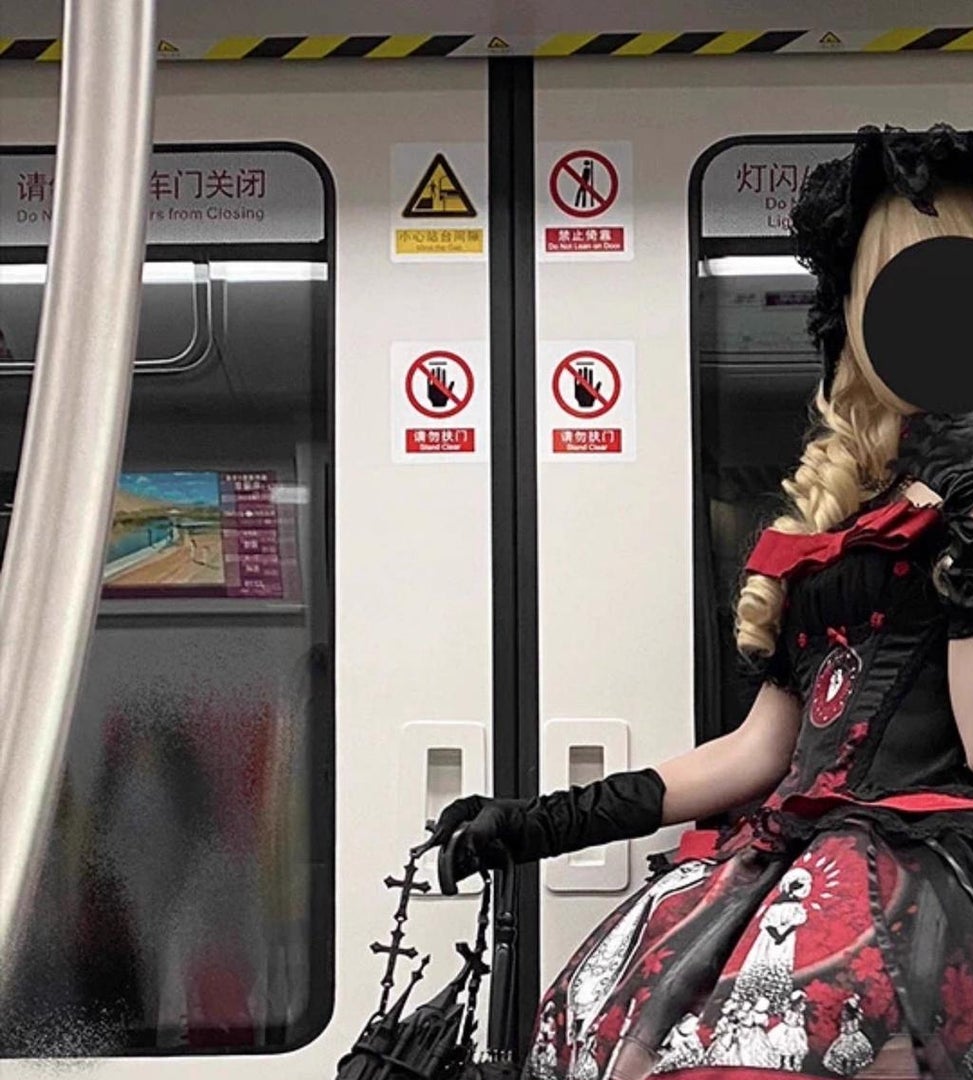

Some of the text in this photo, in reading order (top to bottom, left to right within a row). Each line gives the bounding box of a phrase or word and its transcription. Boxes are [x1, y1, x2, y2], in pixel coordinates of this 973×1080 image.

[765, 197, 787, 210] Do
[17, 209, 38, 223] Do
[169, 207, 202, 220] from
[206, 205, 265, 221] Closing
[548, 242, 559, 250] Do
